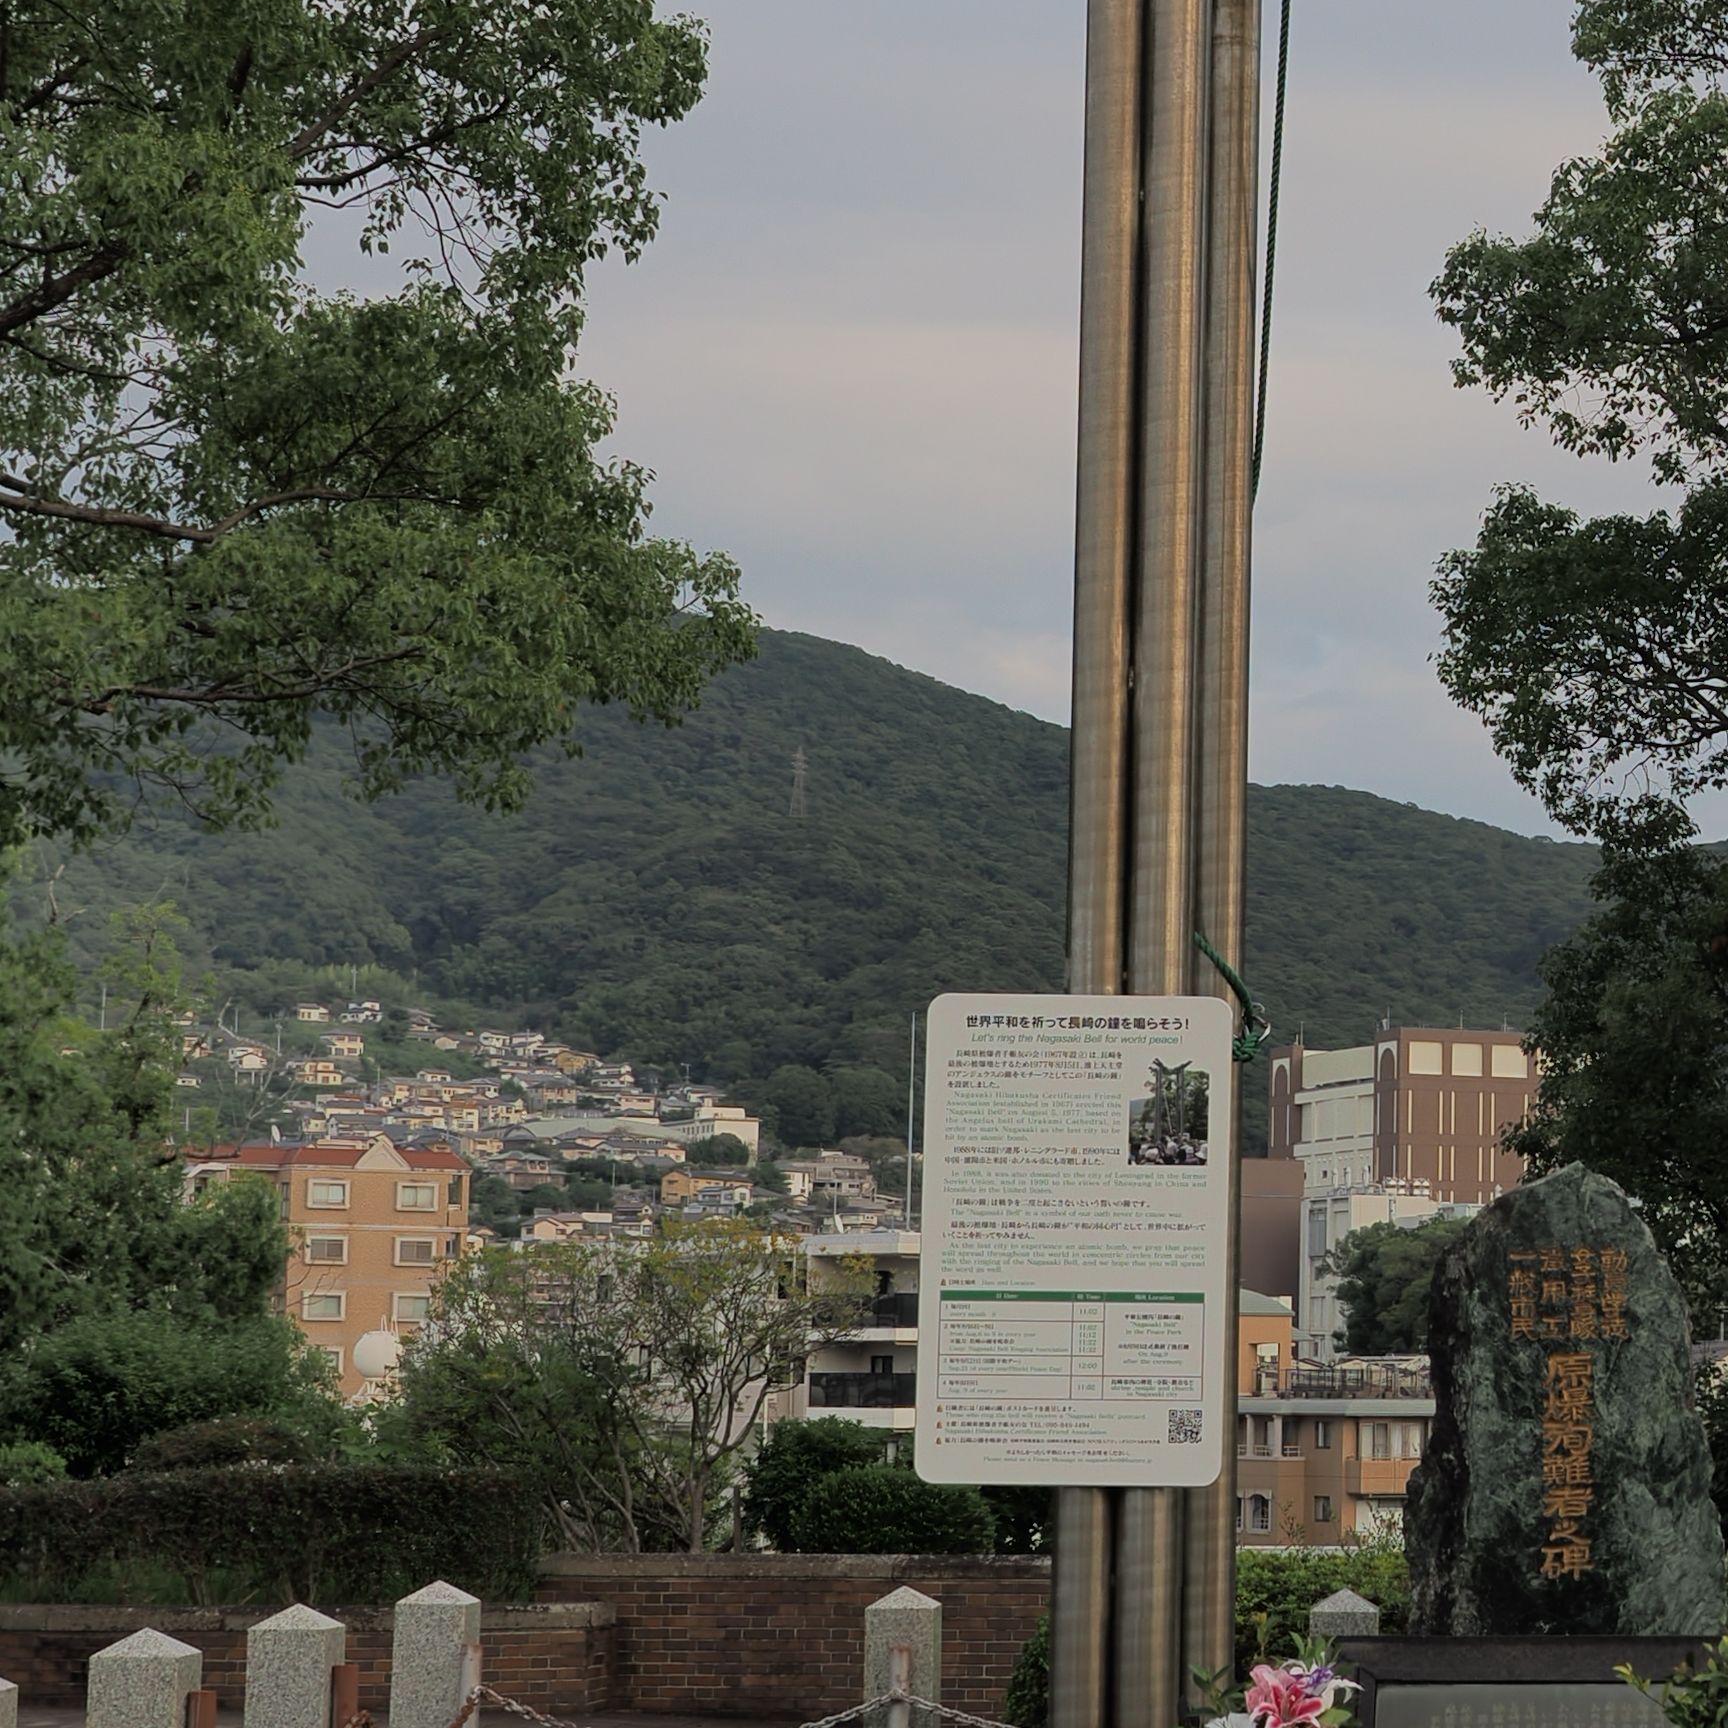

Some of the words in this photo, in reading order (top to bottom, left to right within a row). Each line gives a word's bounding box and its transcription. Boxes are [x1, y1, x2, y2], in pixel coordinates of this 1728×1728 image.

[971, 1033, 995, 1041] Let's
[997, 1034, 1016, 1044] ring
[1018, 1034, 1034, 1042] the
[1036, 1034, 1082, 1045] Nagasaki
[1084, 1034, 1103, 1042] Bell
[1105, 1034, 1119, 1042] for
[1120, 1035, 1147, 1043] world
[1149, 1035, 1182, 1045] peace!
[1508, 1251, 1539, 1340] 一般市民
[1599, 1246, 1629, 1340] 動員学徒
[1539, 1350, 1596, 1582] 原爆殉難者之碑
